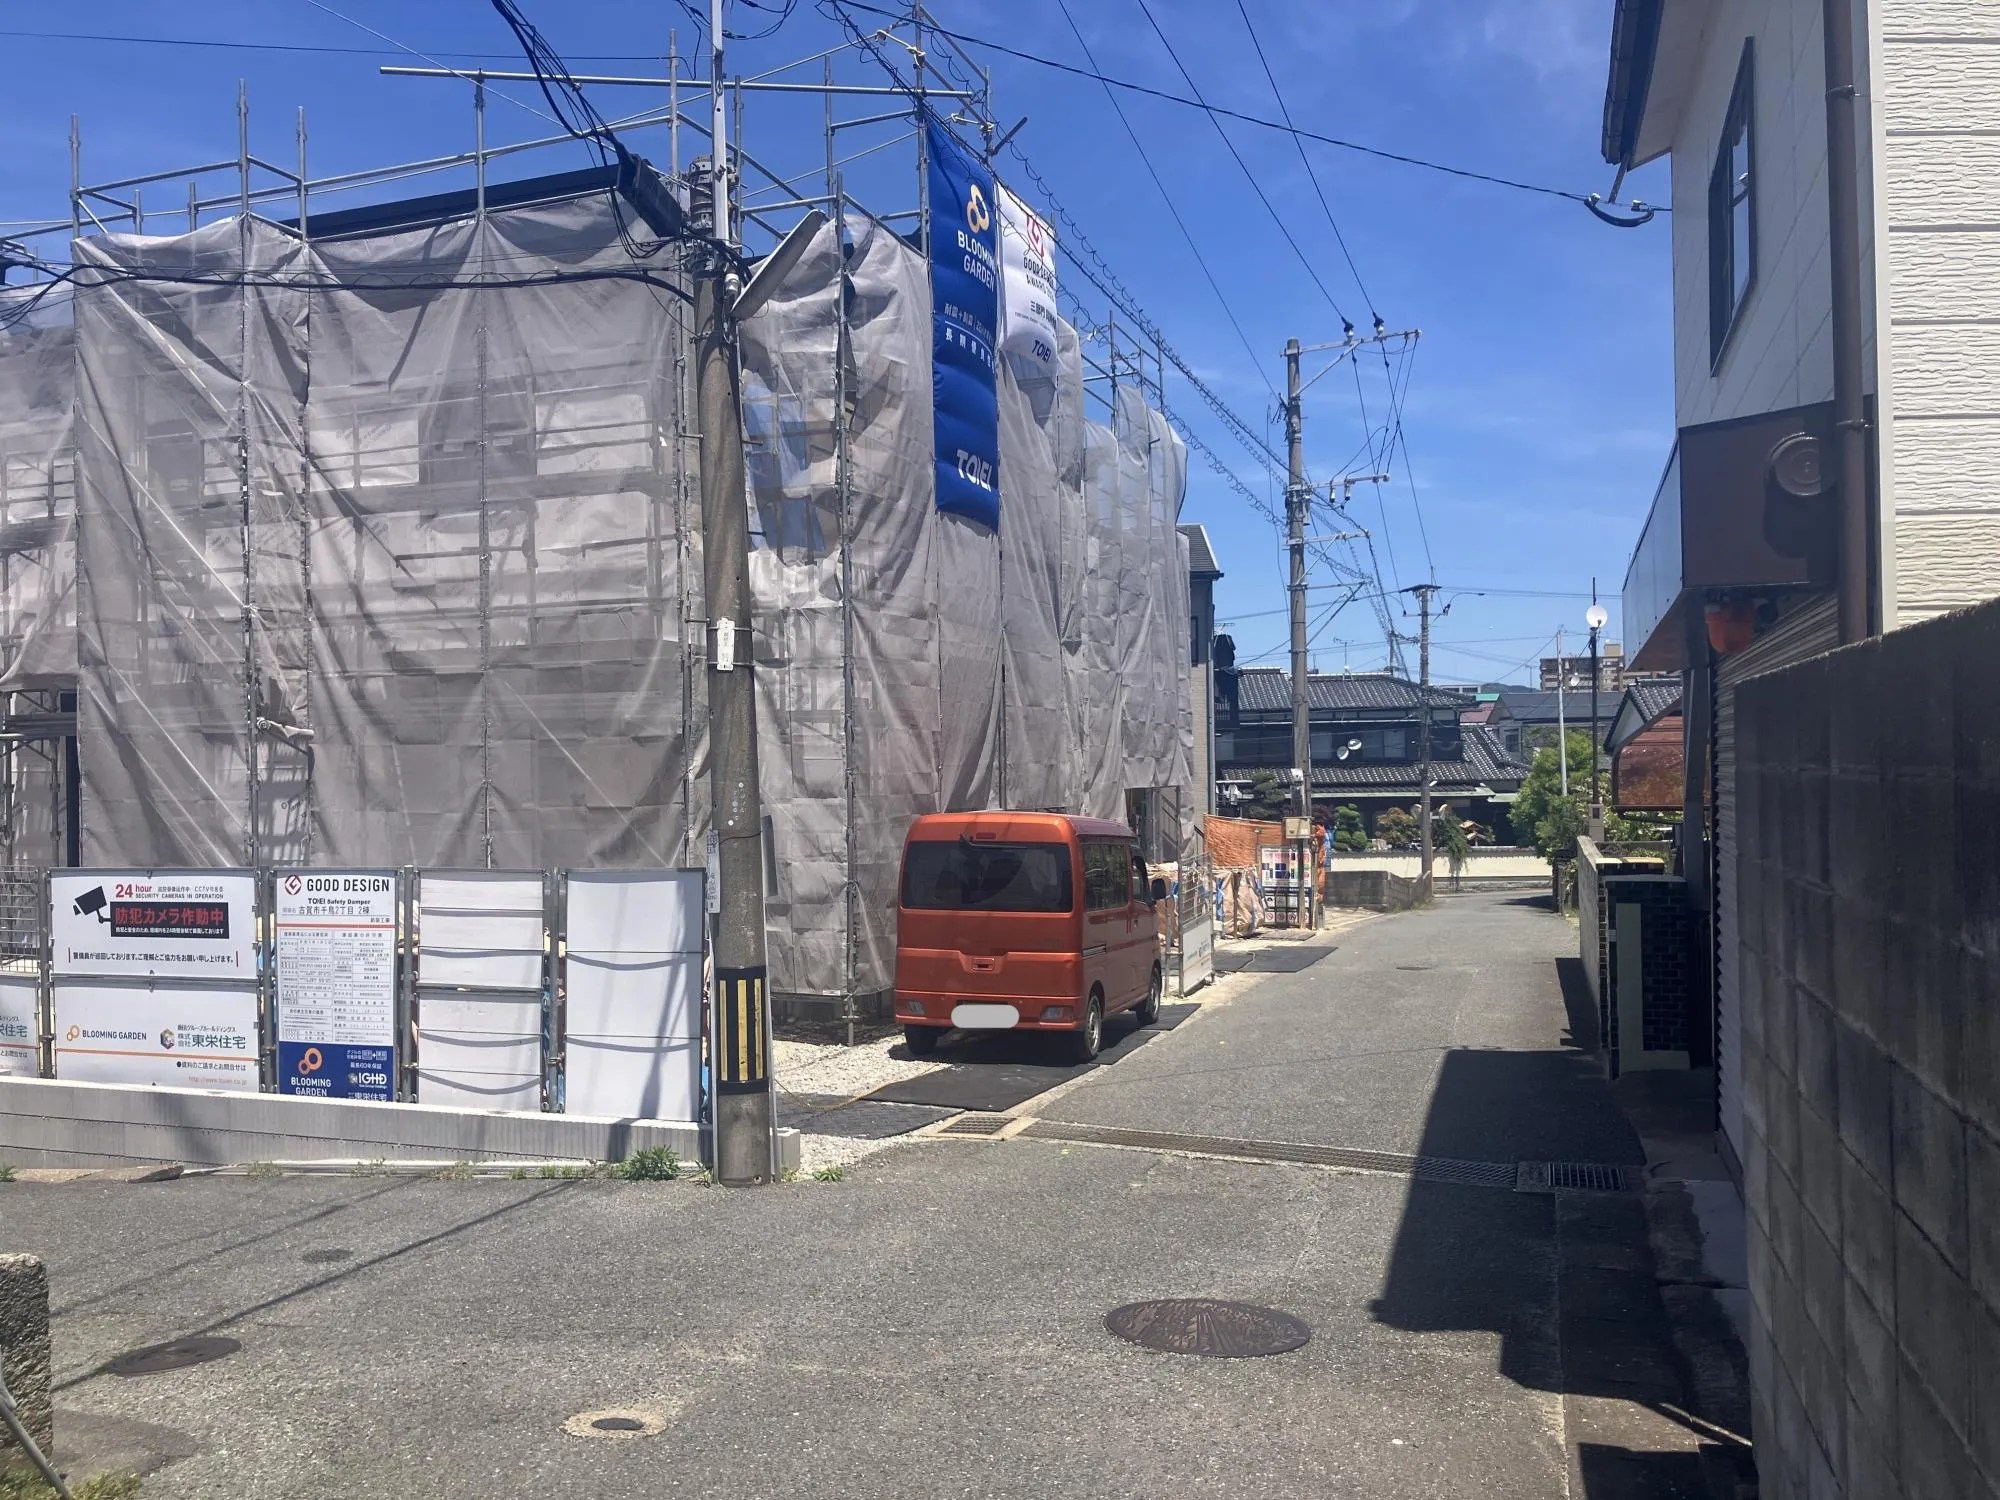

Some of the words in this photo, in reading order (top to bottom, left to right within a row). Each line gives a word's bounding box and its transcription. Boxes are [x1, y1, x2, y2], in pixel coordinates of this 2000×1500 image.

[1023, 256, 1039, 275] GOOD
[963, 254, 995, 292] GARDEN
[115, 884, 133, 898] 24
[135, 884, 152, 893] hour
[307, 878, 340, 892] GOOD
[343, 878, 390, 892] DESIGN
[115, 907, 224, 925] 防犯カメラ作動中
[82, 1029, 118, 1039] BLOOMING
[118, 1031, 147, 1041] GARDEN
[192, 1034, 246, 1049] 東栄住宅
[290, 1076, 332, 1088] BLOOMING
[358, 1072, 387, 1085] IGHD
[295, 1087, 328, 1097] GARDEN
